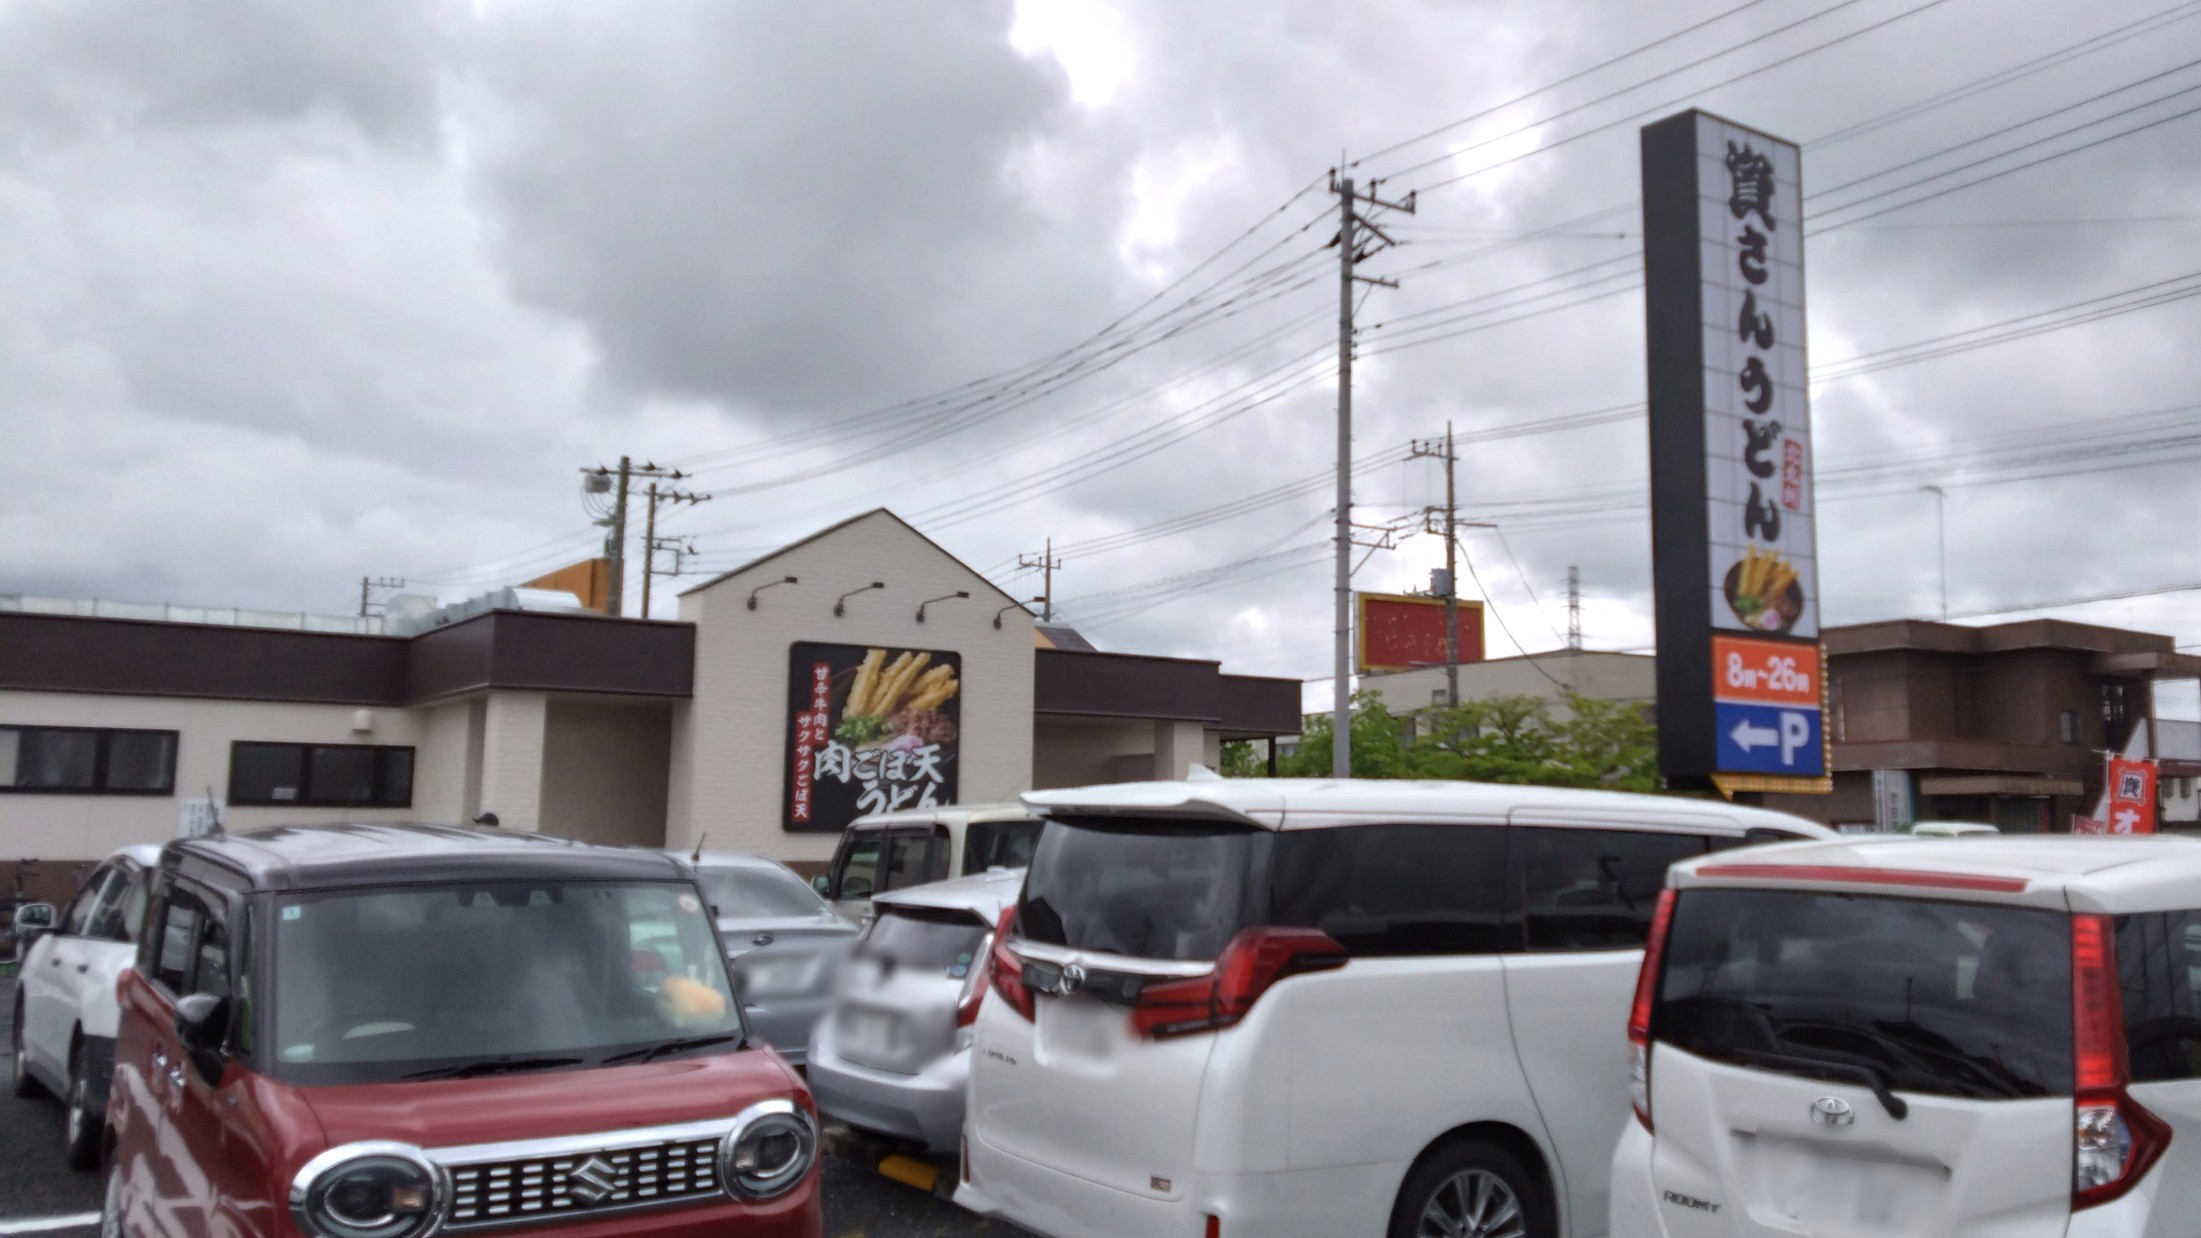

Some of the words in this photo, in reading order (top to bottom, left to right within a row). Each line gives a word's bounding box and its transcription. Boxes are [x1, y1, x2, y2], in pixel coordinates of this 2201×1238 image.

[1726, 138, 1782, 543] 資さんうどん
[813, 739, 944, 784] 肉ごぼ天
[1780, 711, 1810, 766] P
